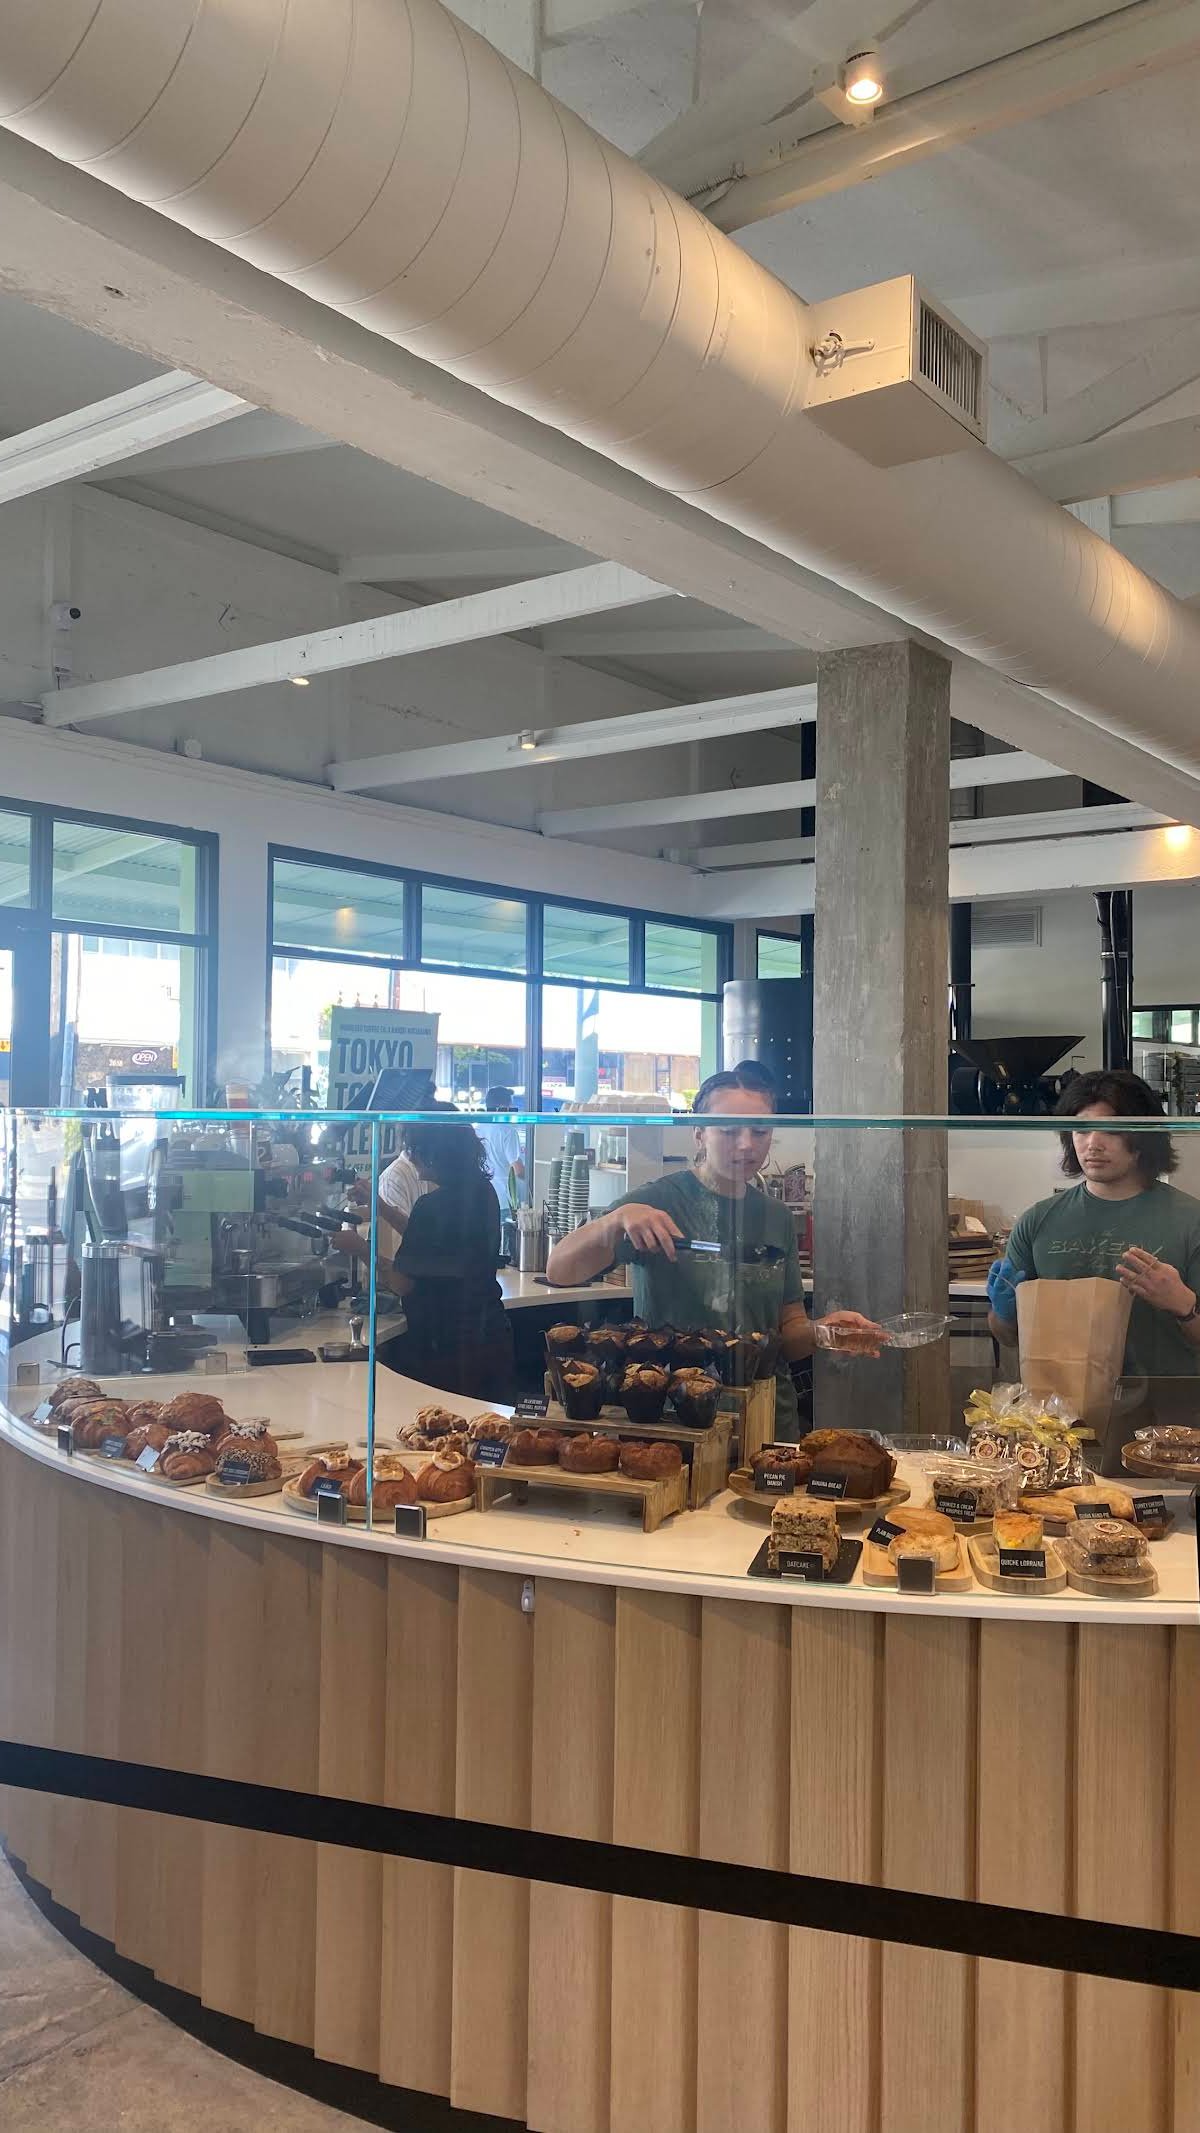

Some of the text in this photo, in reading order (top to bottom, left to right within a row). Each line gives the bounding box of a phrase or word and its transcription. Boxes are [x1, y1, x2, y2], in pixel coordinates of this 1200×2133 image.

[136, 1052, 154, 1062] OPEN
[337, 1037, 414, 1075] TOKYO
[828, 1482, 842, 1490] BREAD
[787, 1561, 810, 1569] OATCAKE
[1020, 1560, 1045, 1568] LORRAINE
